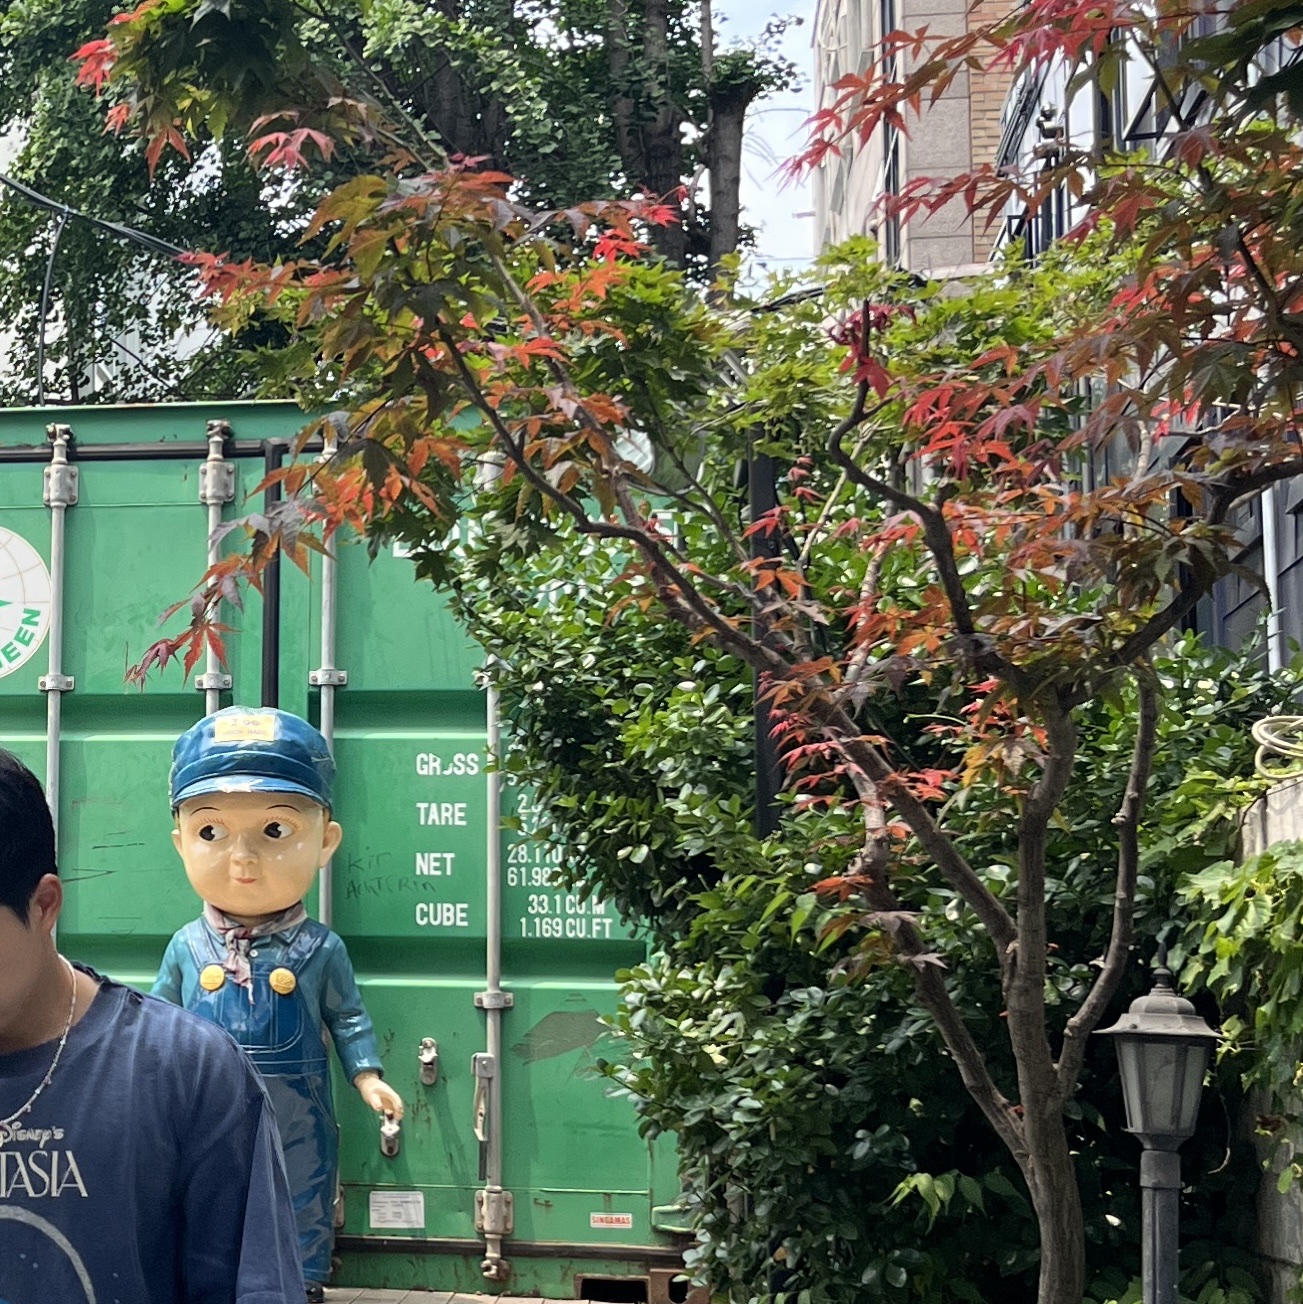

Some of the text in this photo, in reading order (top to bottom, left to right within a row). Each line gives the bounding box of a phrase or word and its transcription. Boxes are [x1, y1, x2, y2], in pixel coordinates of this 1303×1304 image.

[415, 803, 467, 826] TARE
[415, 853, 456, 876] NET
[415, 903, 469, 926] CUBE
[527, 894, 561, 915] 33.1
[520, 917, 613, 938] 1.169 CU.FT
